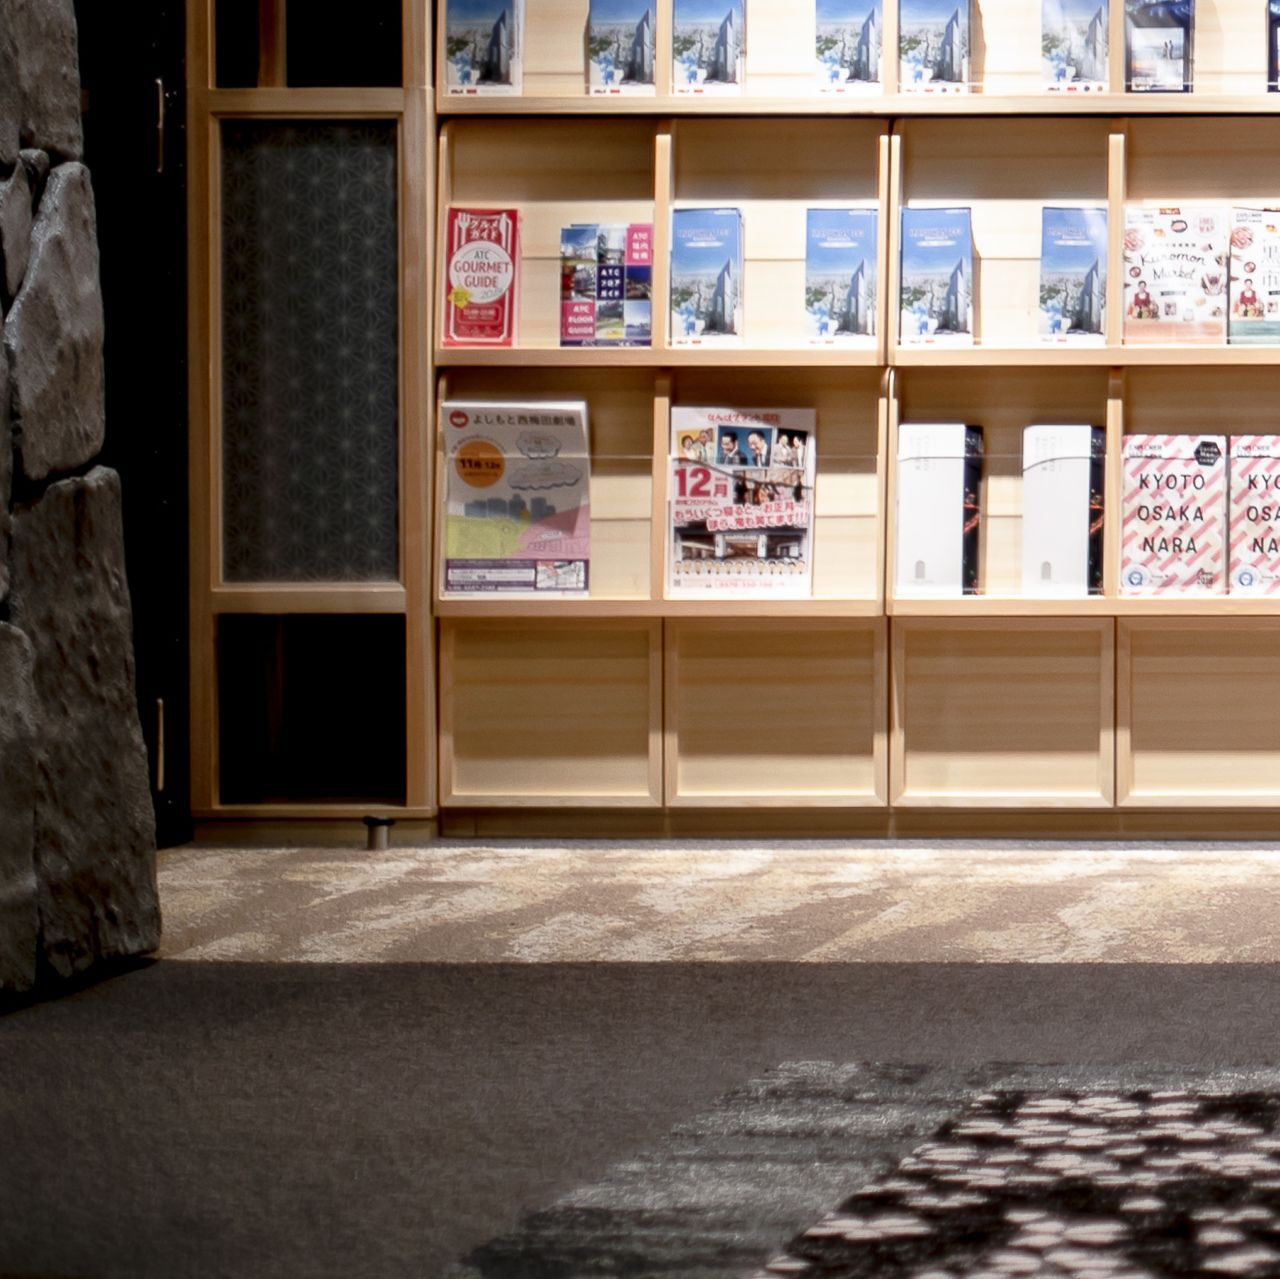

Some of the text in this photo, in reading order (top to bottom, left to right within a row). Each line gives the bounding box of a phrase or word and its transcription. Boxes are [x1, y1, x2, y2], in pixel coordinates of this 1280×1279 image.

[474, 250, 490, 260] ATC
[454, 260, 509, 274] GOURMET
[601, 269, 620, 277] ATC
[464, 275, 500, 288] GUIDE
[674, 467, 729, 498] 12月
[1139, 473, 1205, 490] KYOTO
[1137, 505, 1204, 522] OSAKA
[1143, 536, 1198, 554] NARA
